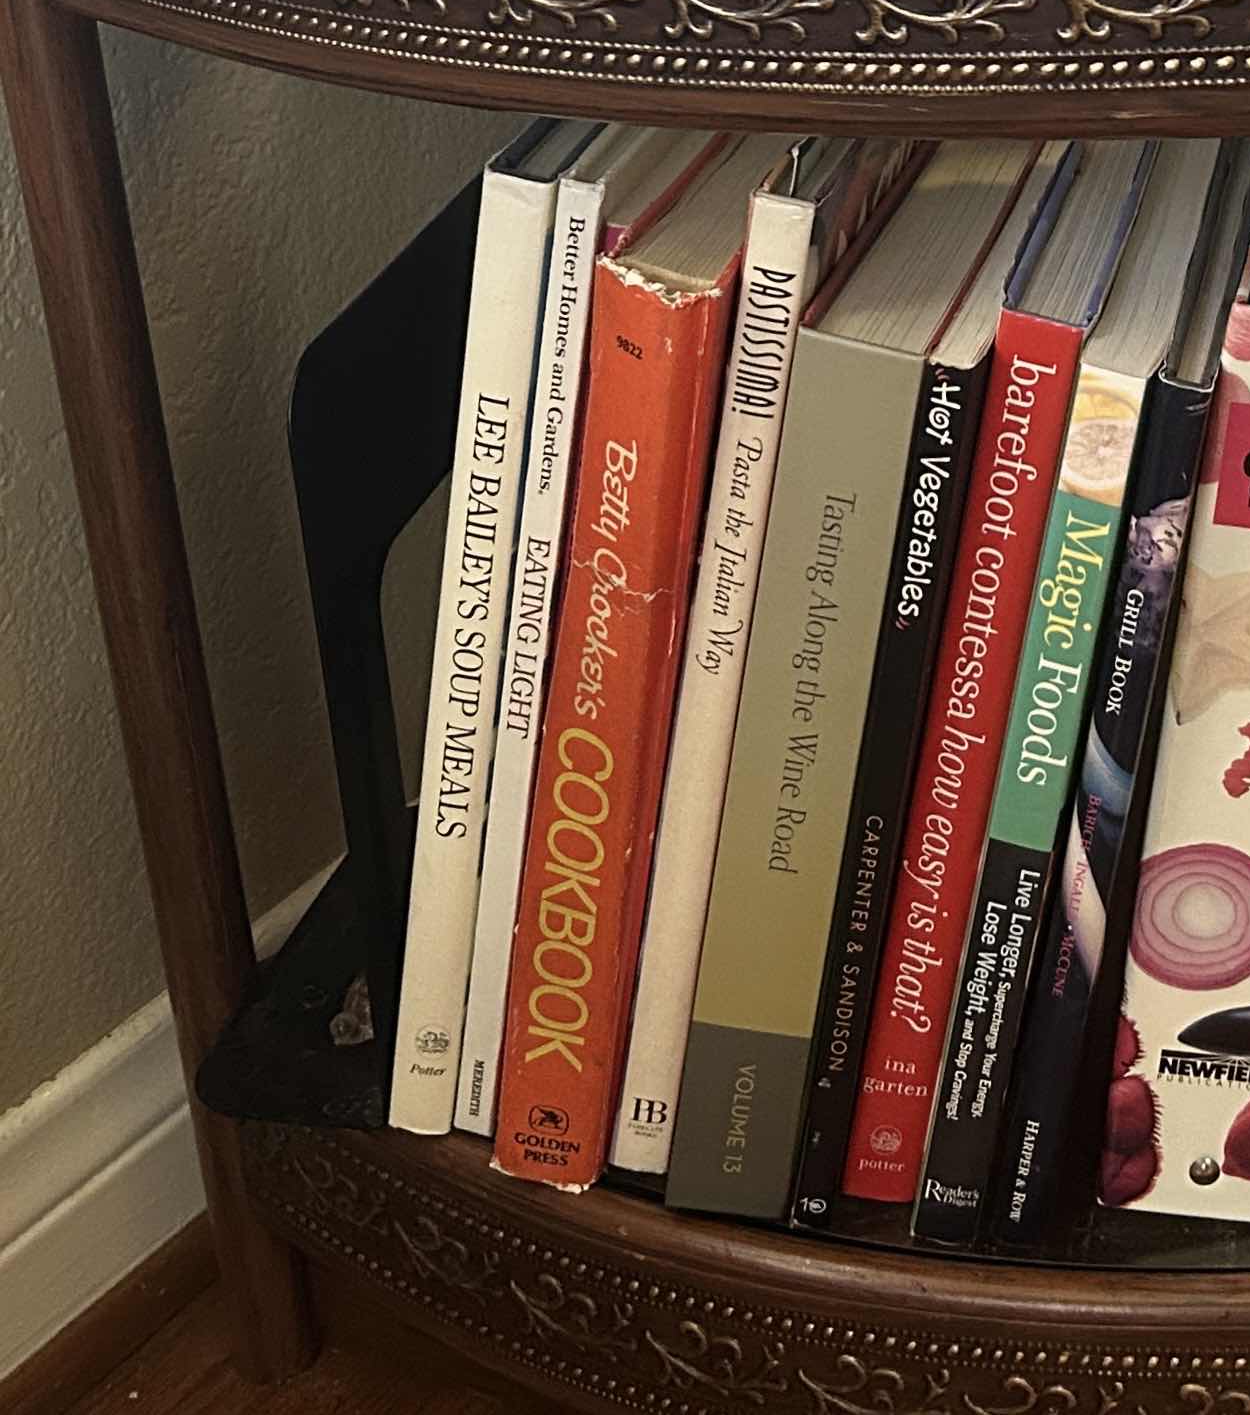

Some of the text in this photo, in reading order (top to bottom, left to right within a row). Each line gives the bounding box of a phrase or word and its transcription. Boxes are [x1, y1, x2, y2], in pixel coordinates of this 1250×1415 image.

[550, 215, 586, 401] Better Homes and
[593, 439, 640, 544] Betty
[727, 434, 763, 500] Pasta
[436, 392, 510, 841] LEE BAILEY'S SOUP MEALS
[928, 354, 1057, 809] barefoot contessa how
[507, 536, 552, 740] EATING LIGHT
[769, 492, 857, 874] Tasting Along Wine Road
[1016, 509, 1110, 787] Magic Foods
[525, 727, 615, 1073] COOKBOOK
[829, 815, 885, 1072] CARPENTER SANDISON
[981, 901, 1008, 945] Lose
[985, 868, 1041, 1049] Live Supercharge
[410, 1062, 448, 1080] Potter
[727, 1064, 758, 1147] VOLUME
[863, 1075, 929, 1099] garten
[884, 1058, 917, 1075] ina
[514, 1131, 581, 1154] GOLDEN
[523, 1149, 569, 1167] PRESS
[858, 1159, 905, 1173] potter
[1017, 1119, 1040, 1175] HARPER
